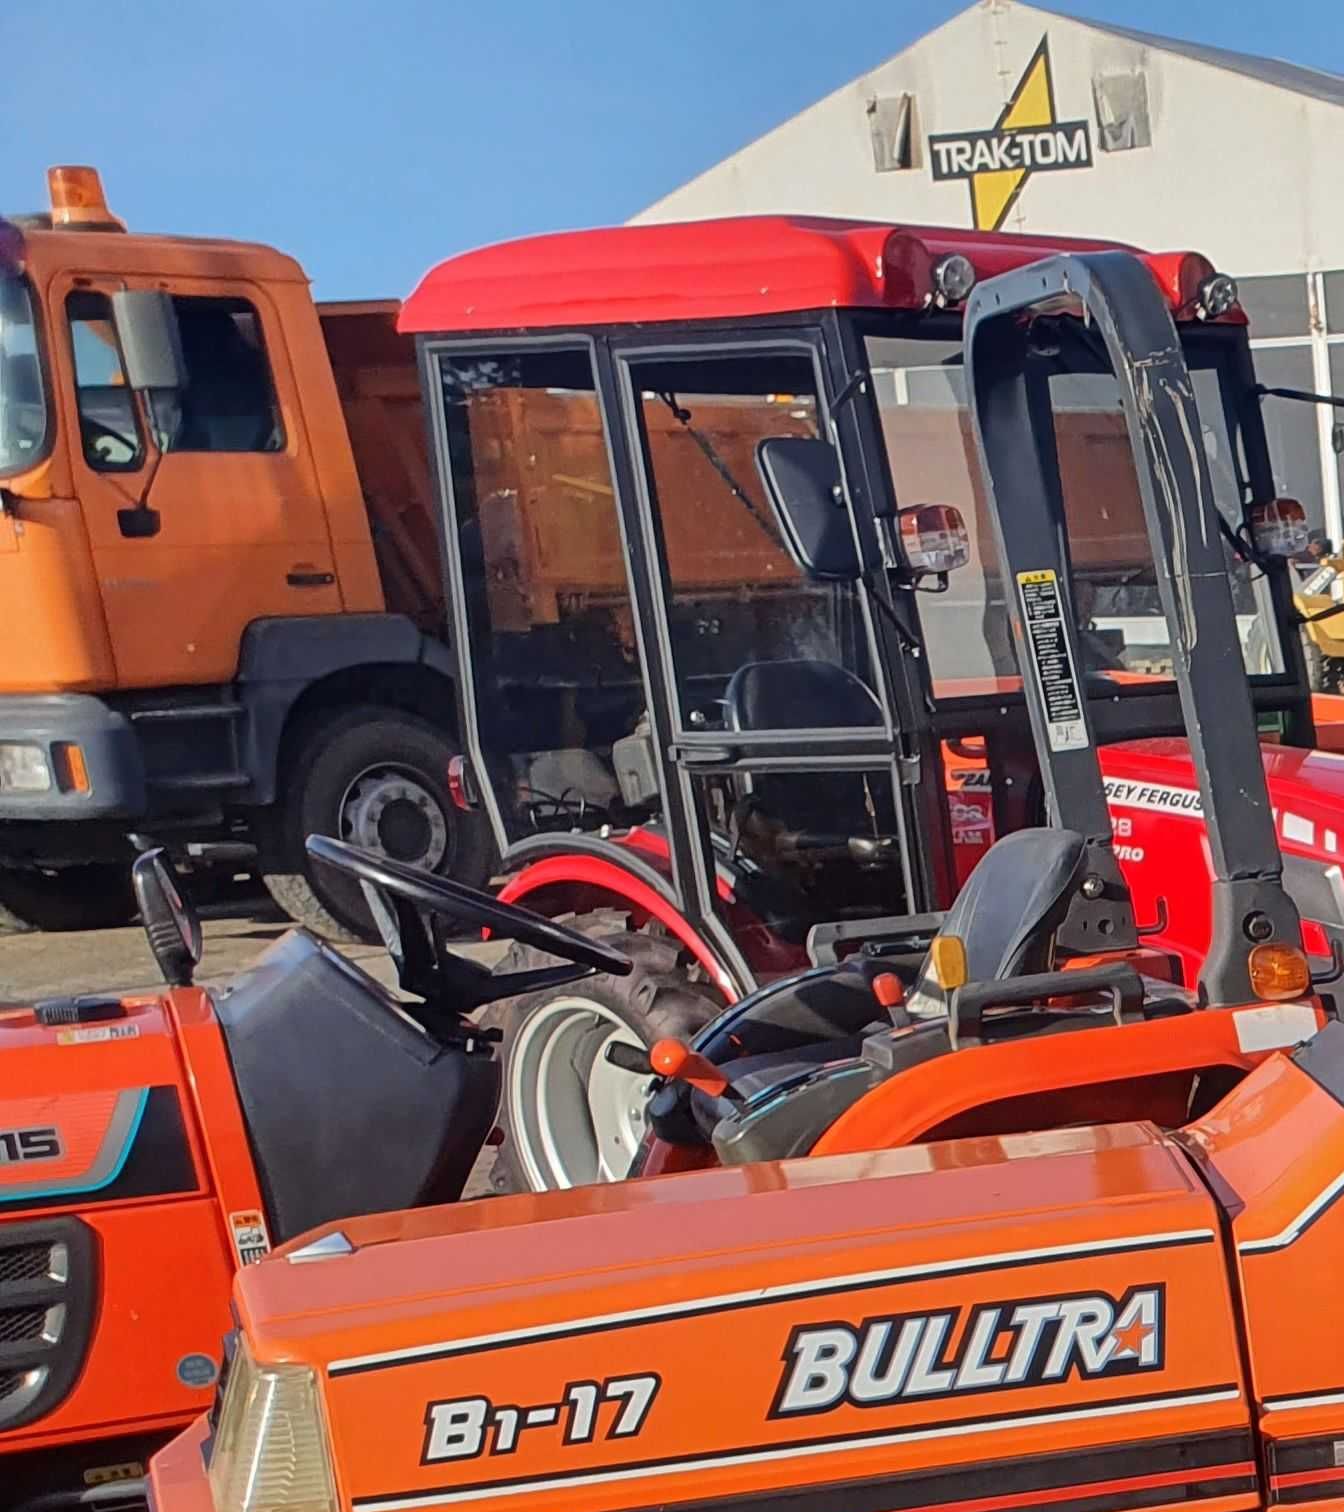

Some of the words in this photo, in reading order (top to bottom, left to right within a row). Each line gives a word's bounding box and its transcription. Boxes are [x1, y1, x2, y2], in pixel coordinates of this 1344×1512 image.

[933, 129, 1088, 175] TRAK-TOM
[766, 1282, 1166, 1420] BULLTRA
[422, 1373, 661, 1464] B1-17
